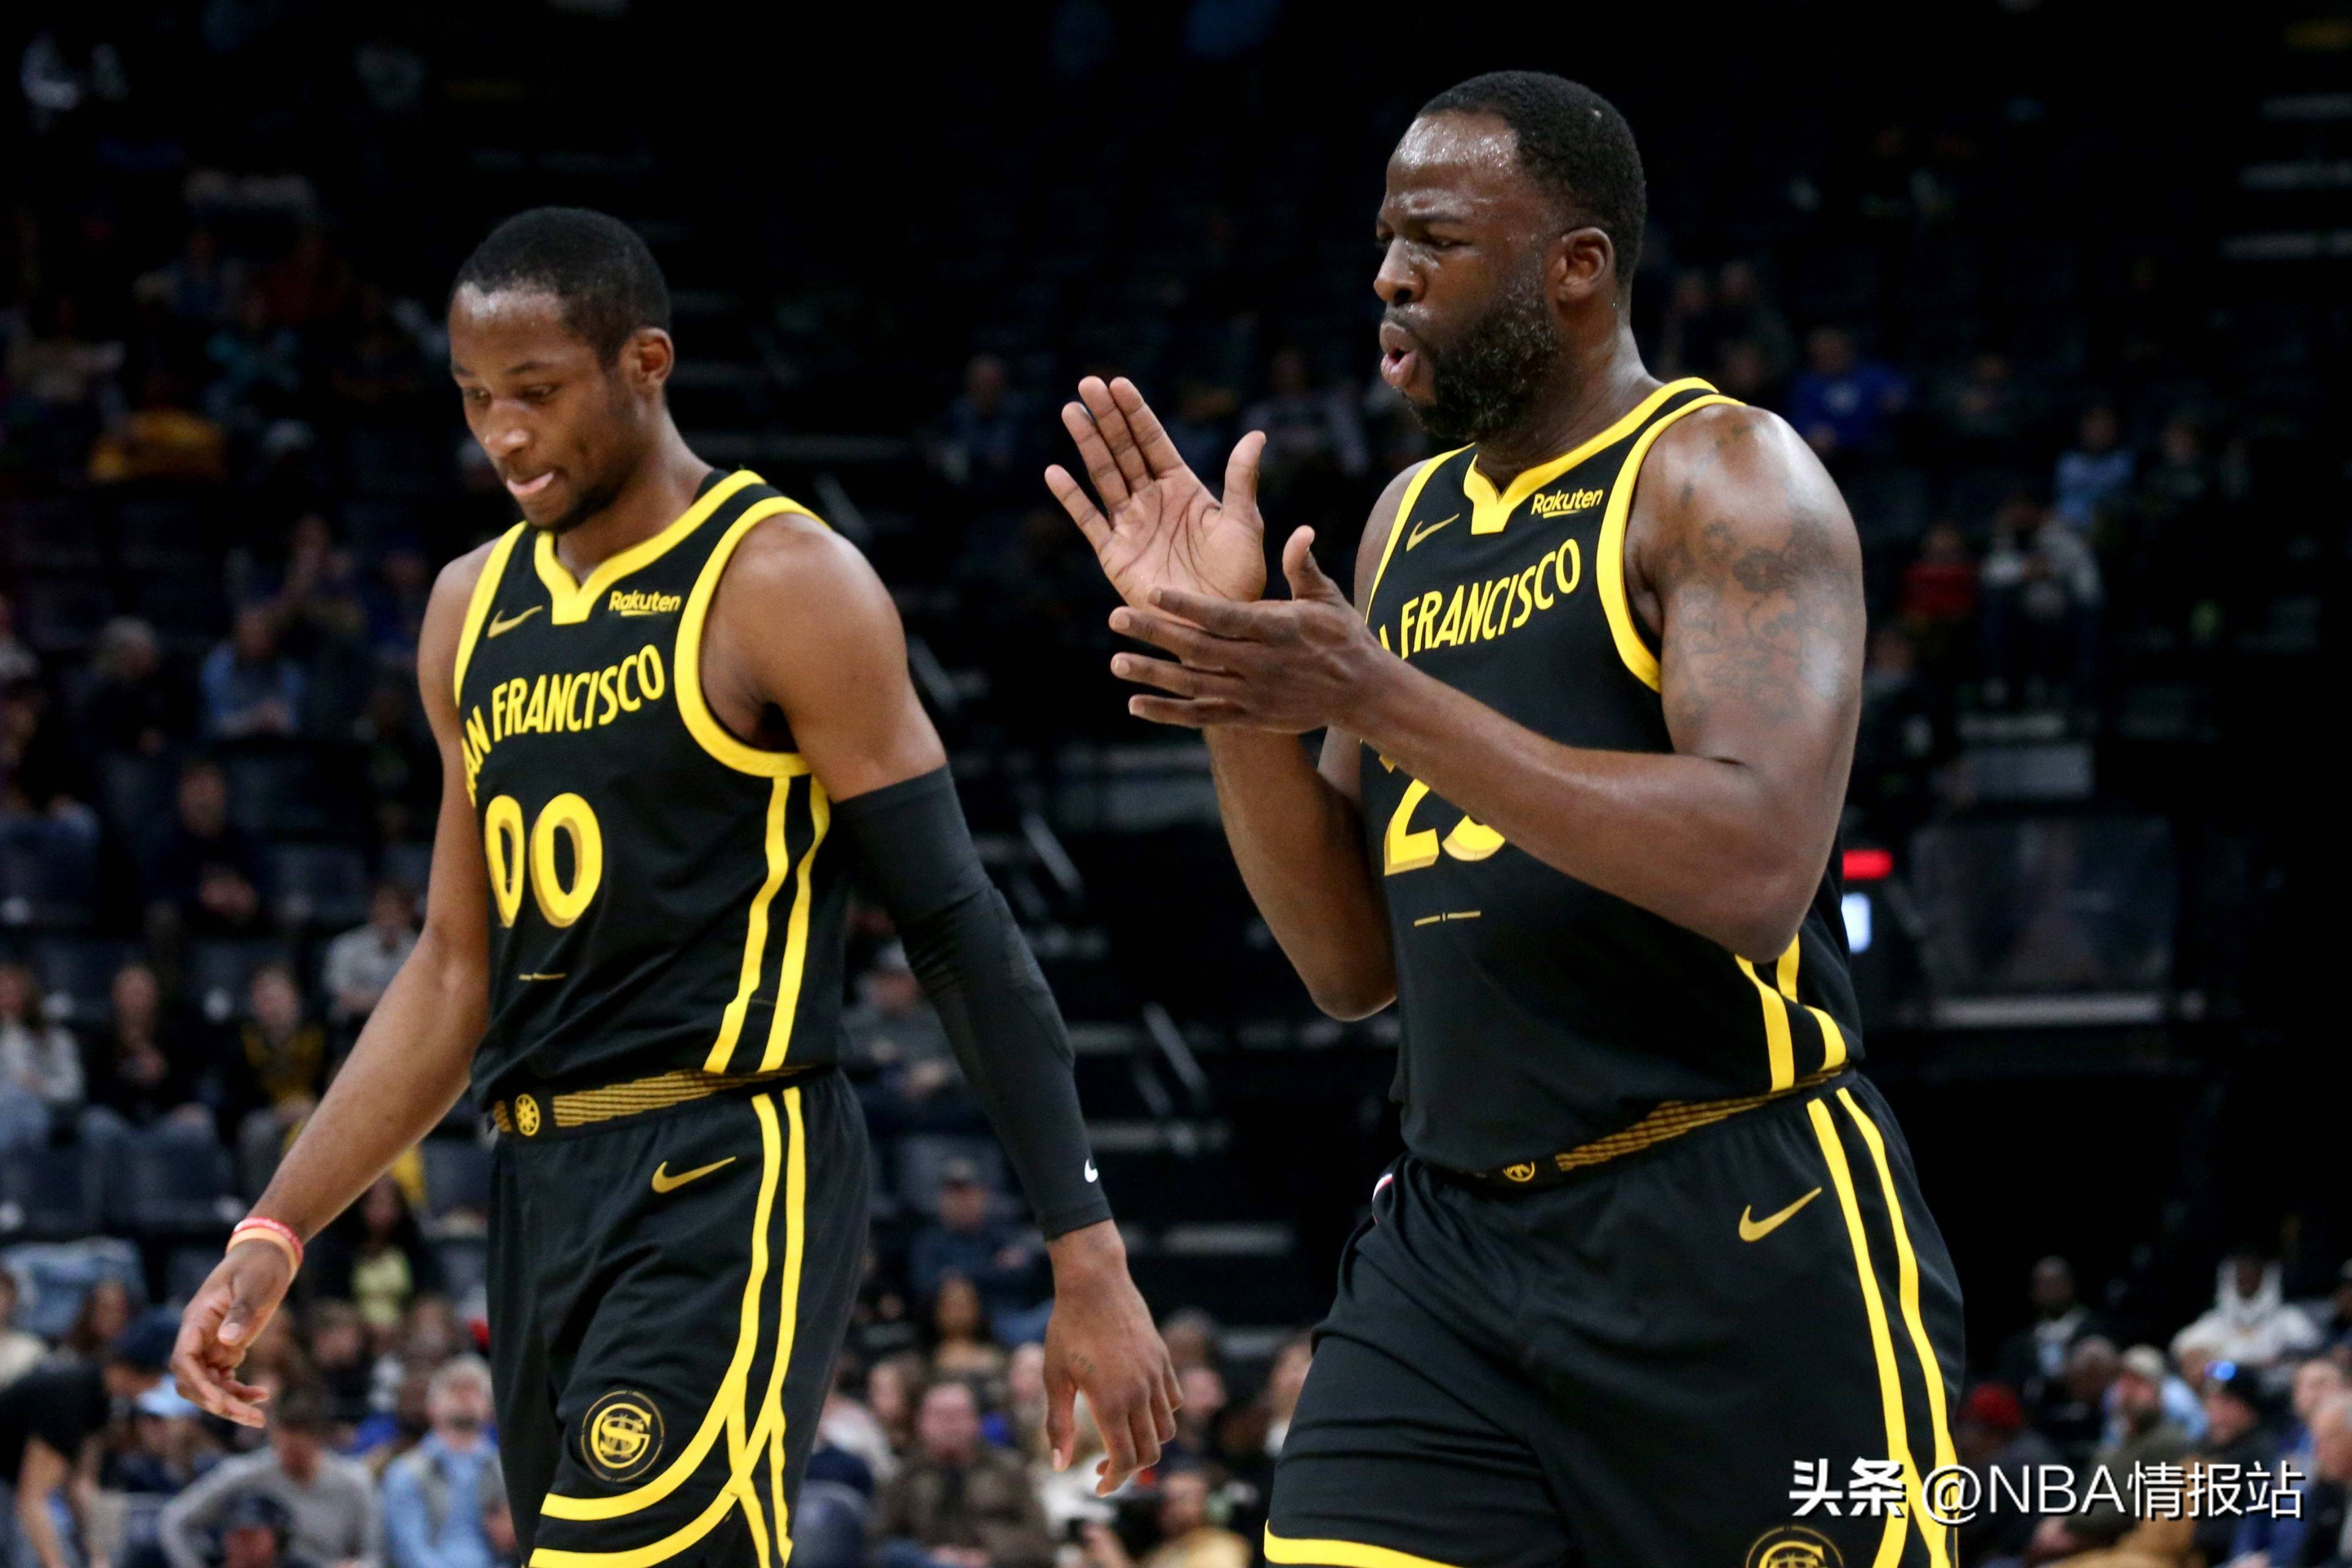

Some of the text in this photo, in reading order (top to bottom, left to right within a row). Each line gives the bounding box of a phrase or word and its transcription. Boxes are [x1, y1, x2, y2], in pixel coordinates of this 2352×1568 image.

[1531, 489, 1603, 518] Rakuten
[609, 590, 681, 616] Rakuten
[1400, 538, 1581, 660] FRANCISCO
[492, 644, 665, 742] FRANCISCO
[484, 793, 603, 927] 00
